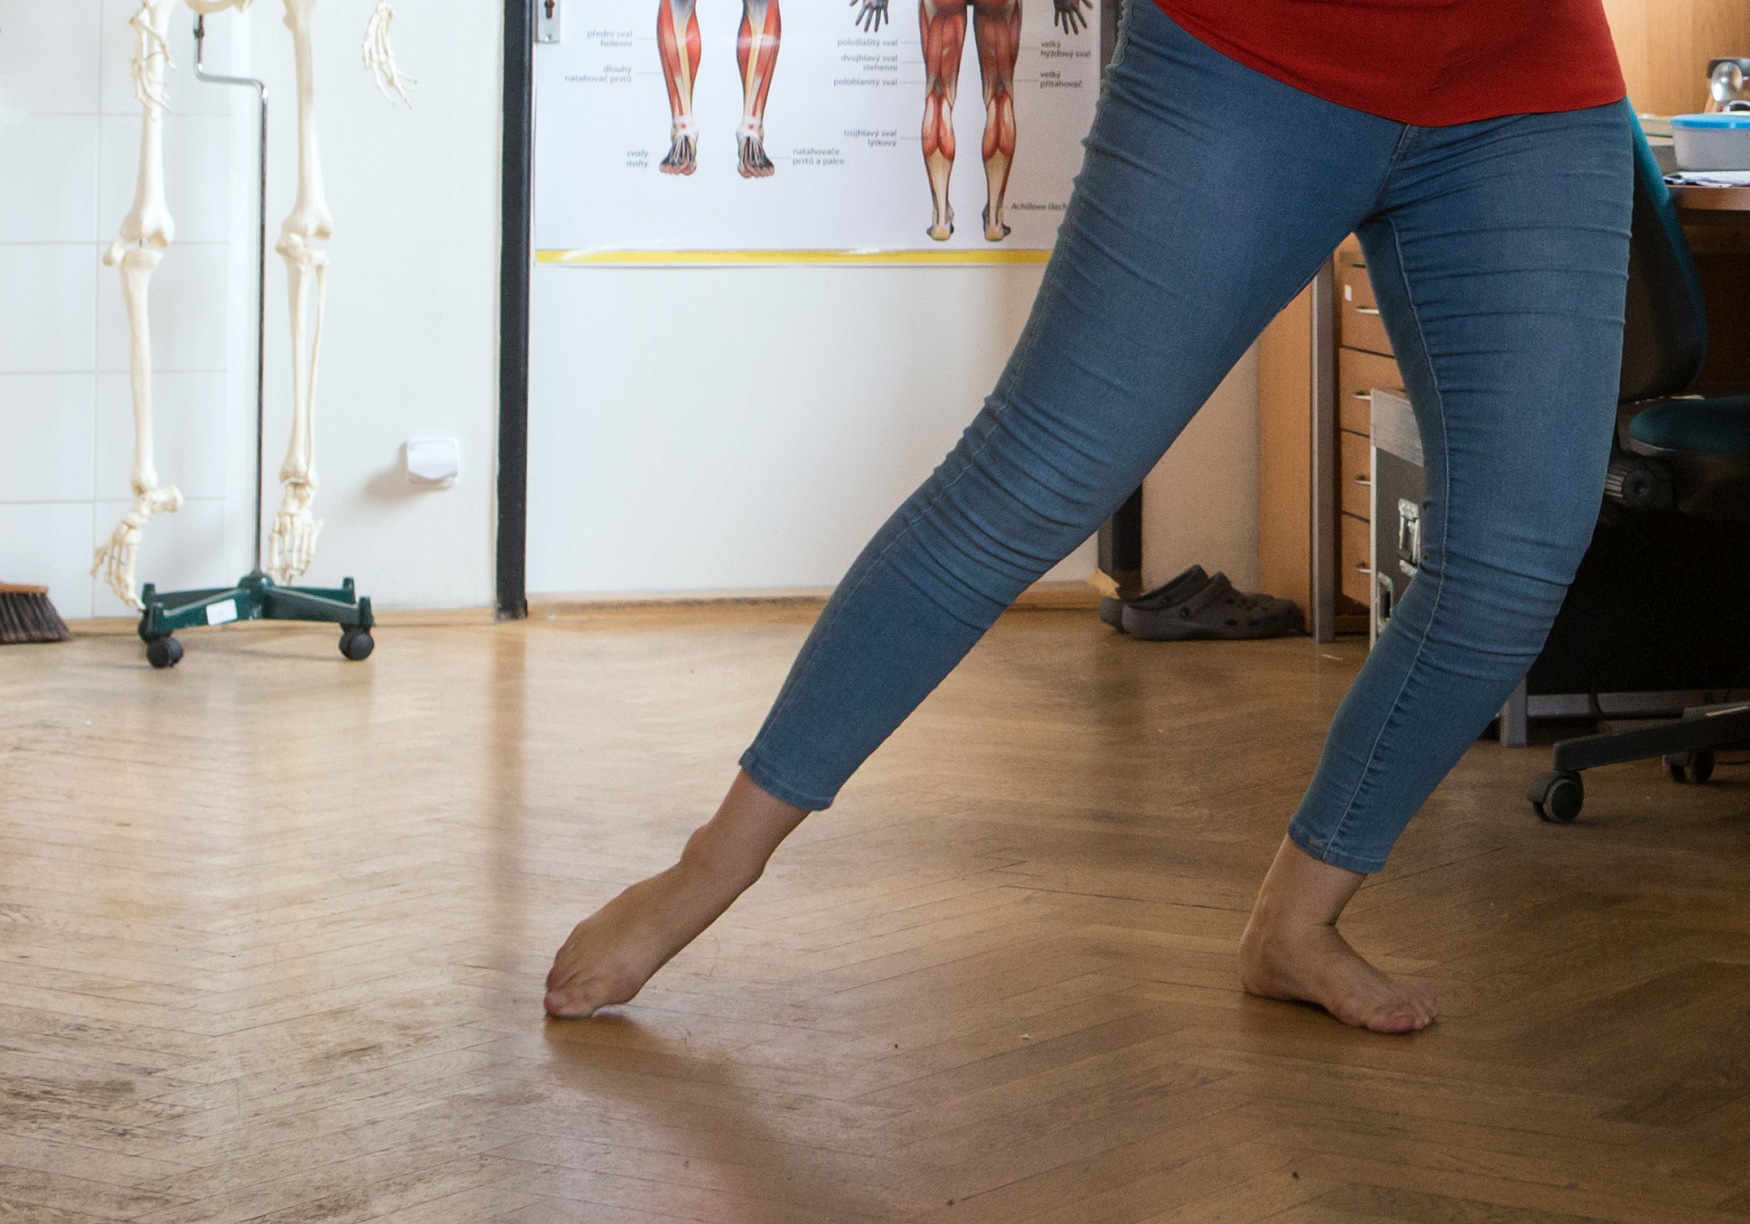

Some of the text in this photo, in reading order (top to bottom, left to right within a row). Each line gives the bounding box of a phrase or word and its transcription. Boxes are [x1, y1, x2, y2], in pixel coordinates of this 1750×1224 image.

[882, 54, 898, 62] sval
[1076, 50, 1091, 58] sval
[626, 150, 648, 158] svaly
[626, 159, 648, 168] nohy
